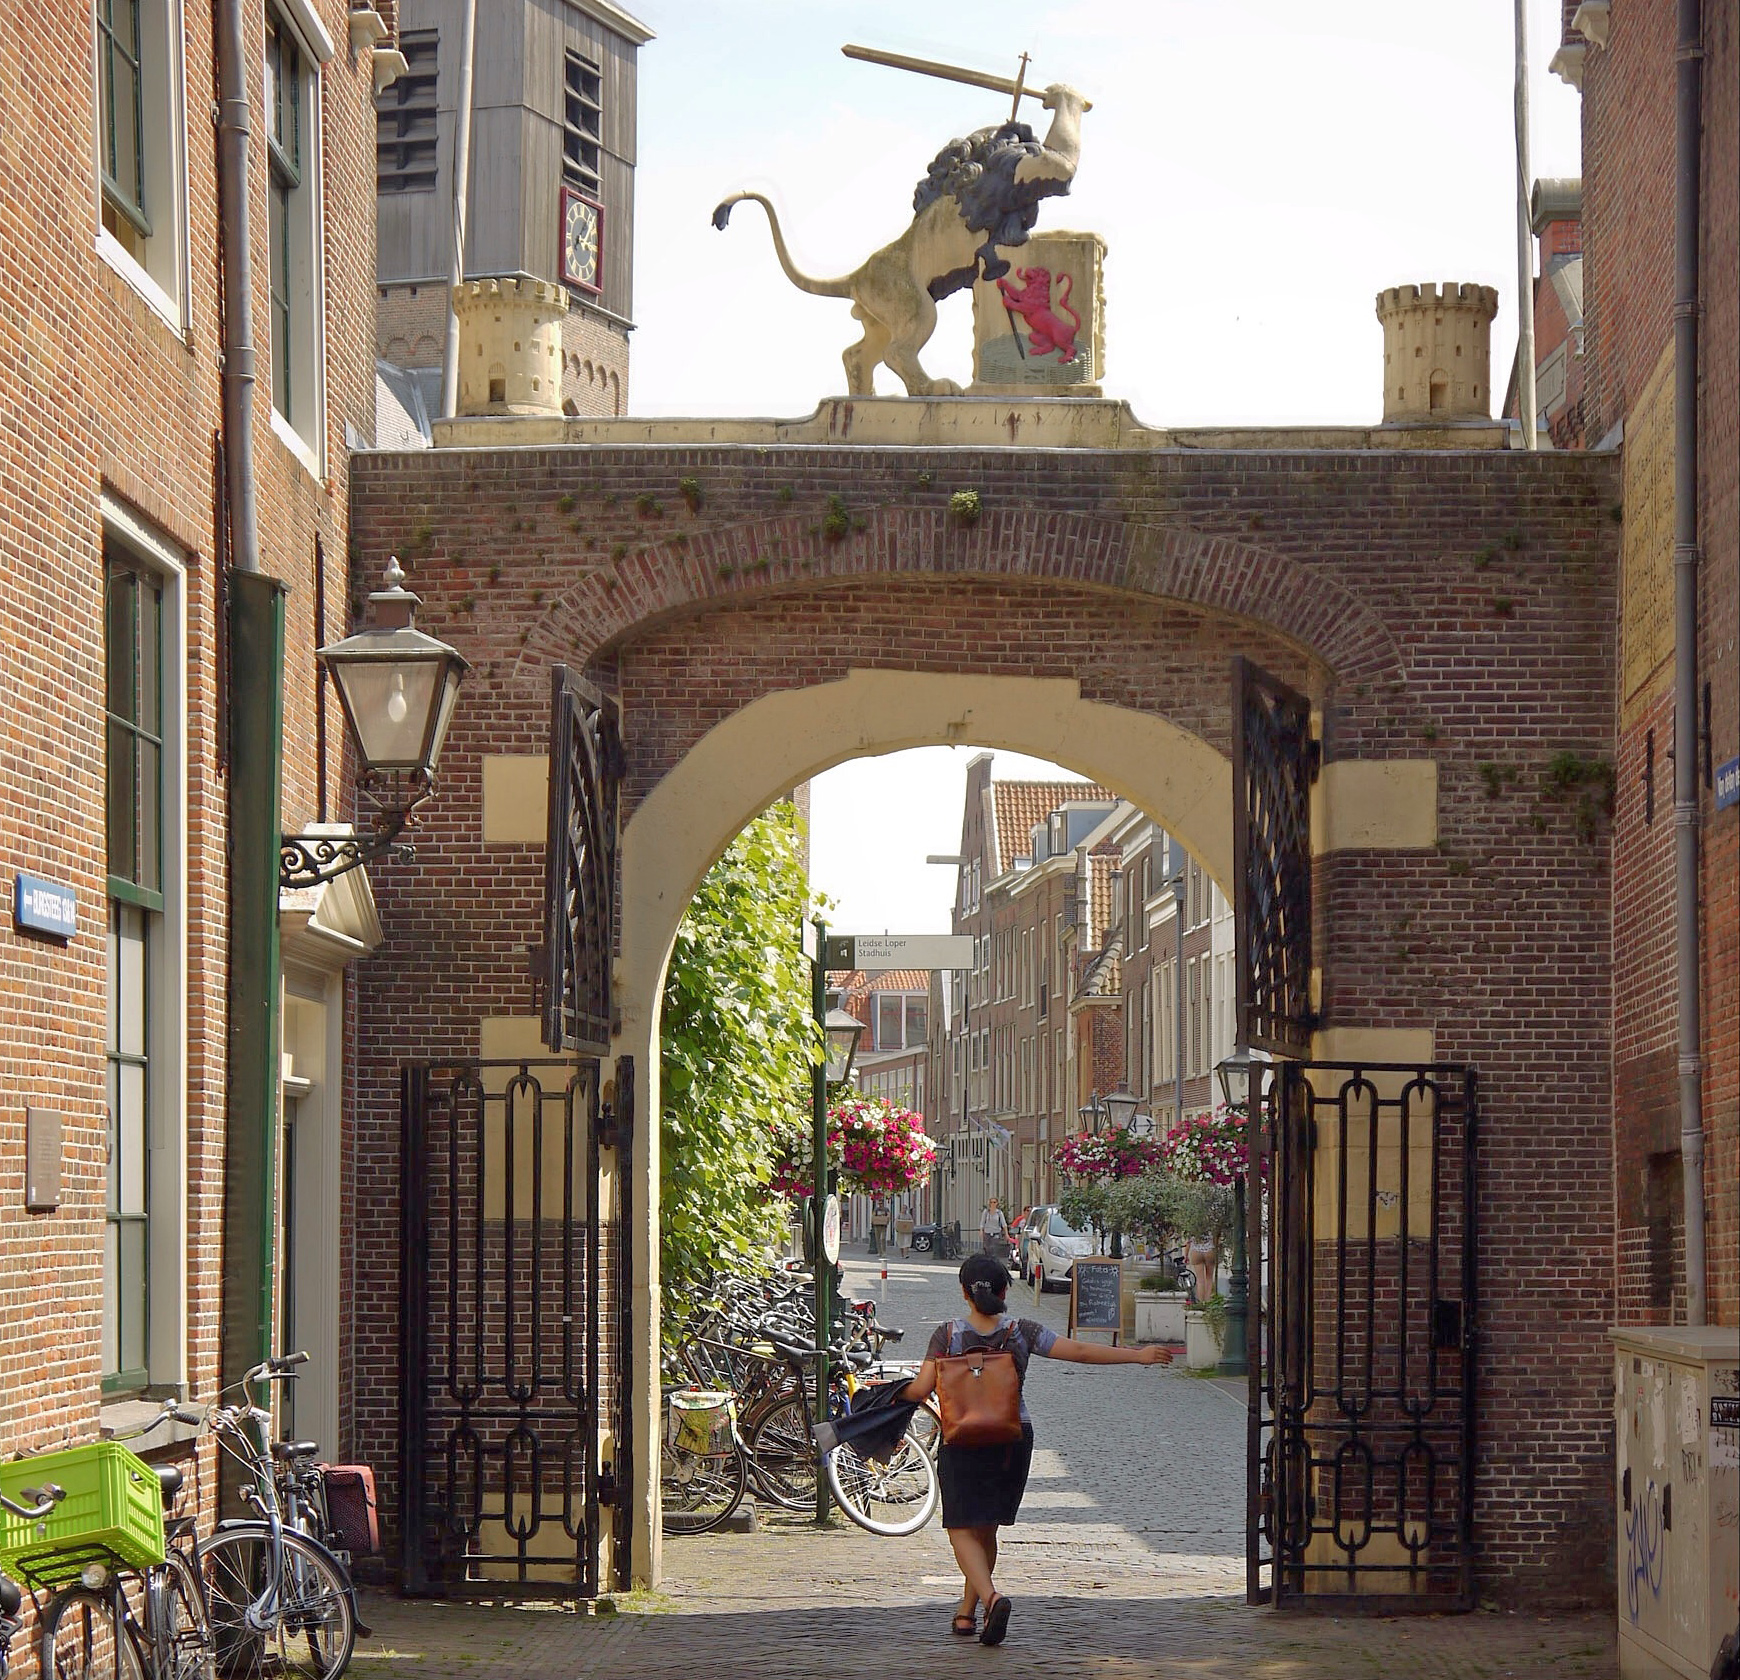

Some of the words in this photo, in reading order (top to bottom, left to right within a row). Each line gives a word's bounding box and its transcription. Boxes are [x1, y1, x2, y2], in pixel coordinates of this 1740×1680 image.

[858, 939, 882, 947] Leidse
[885, 939, 906, 948] Loper
[858, 949, 892, 957] Stadhuis
